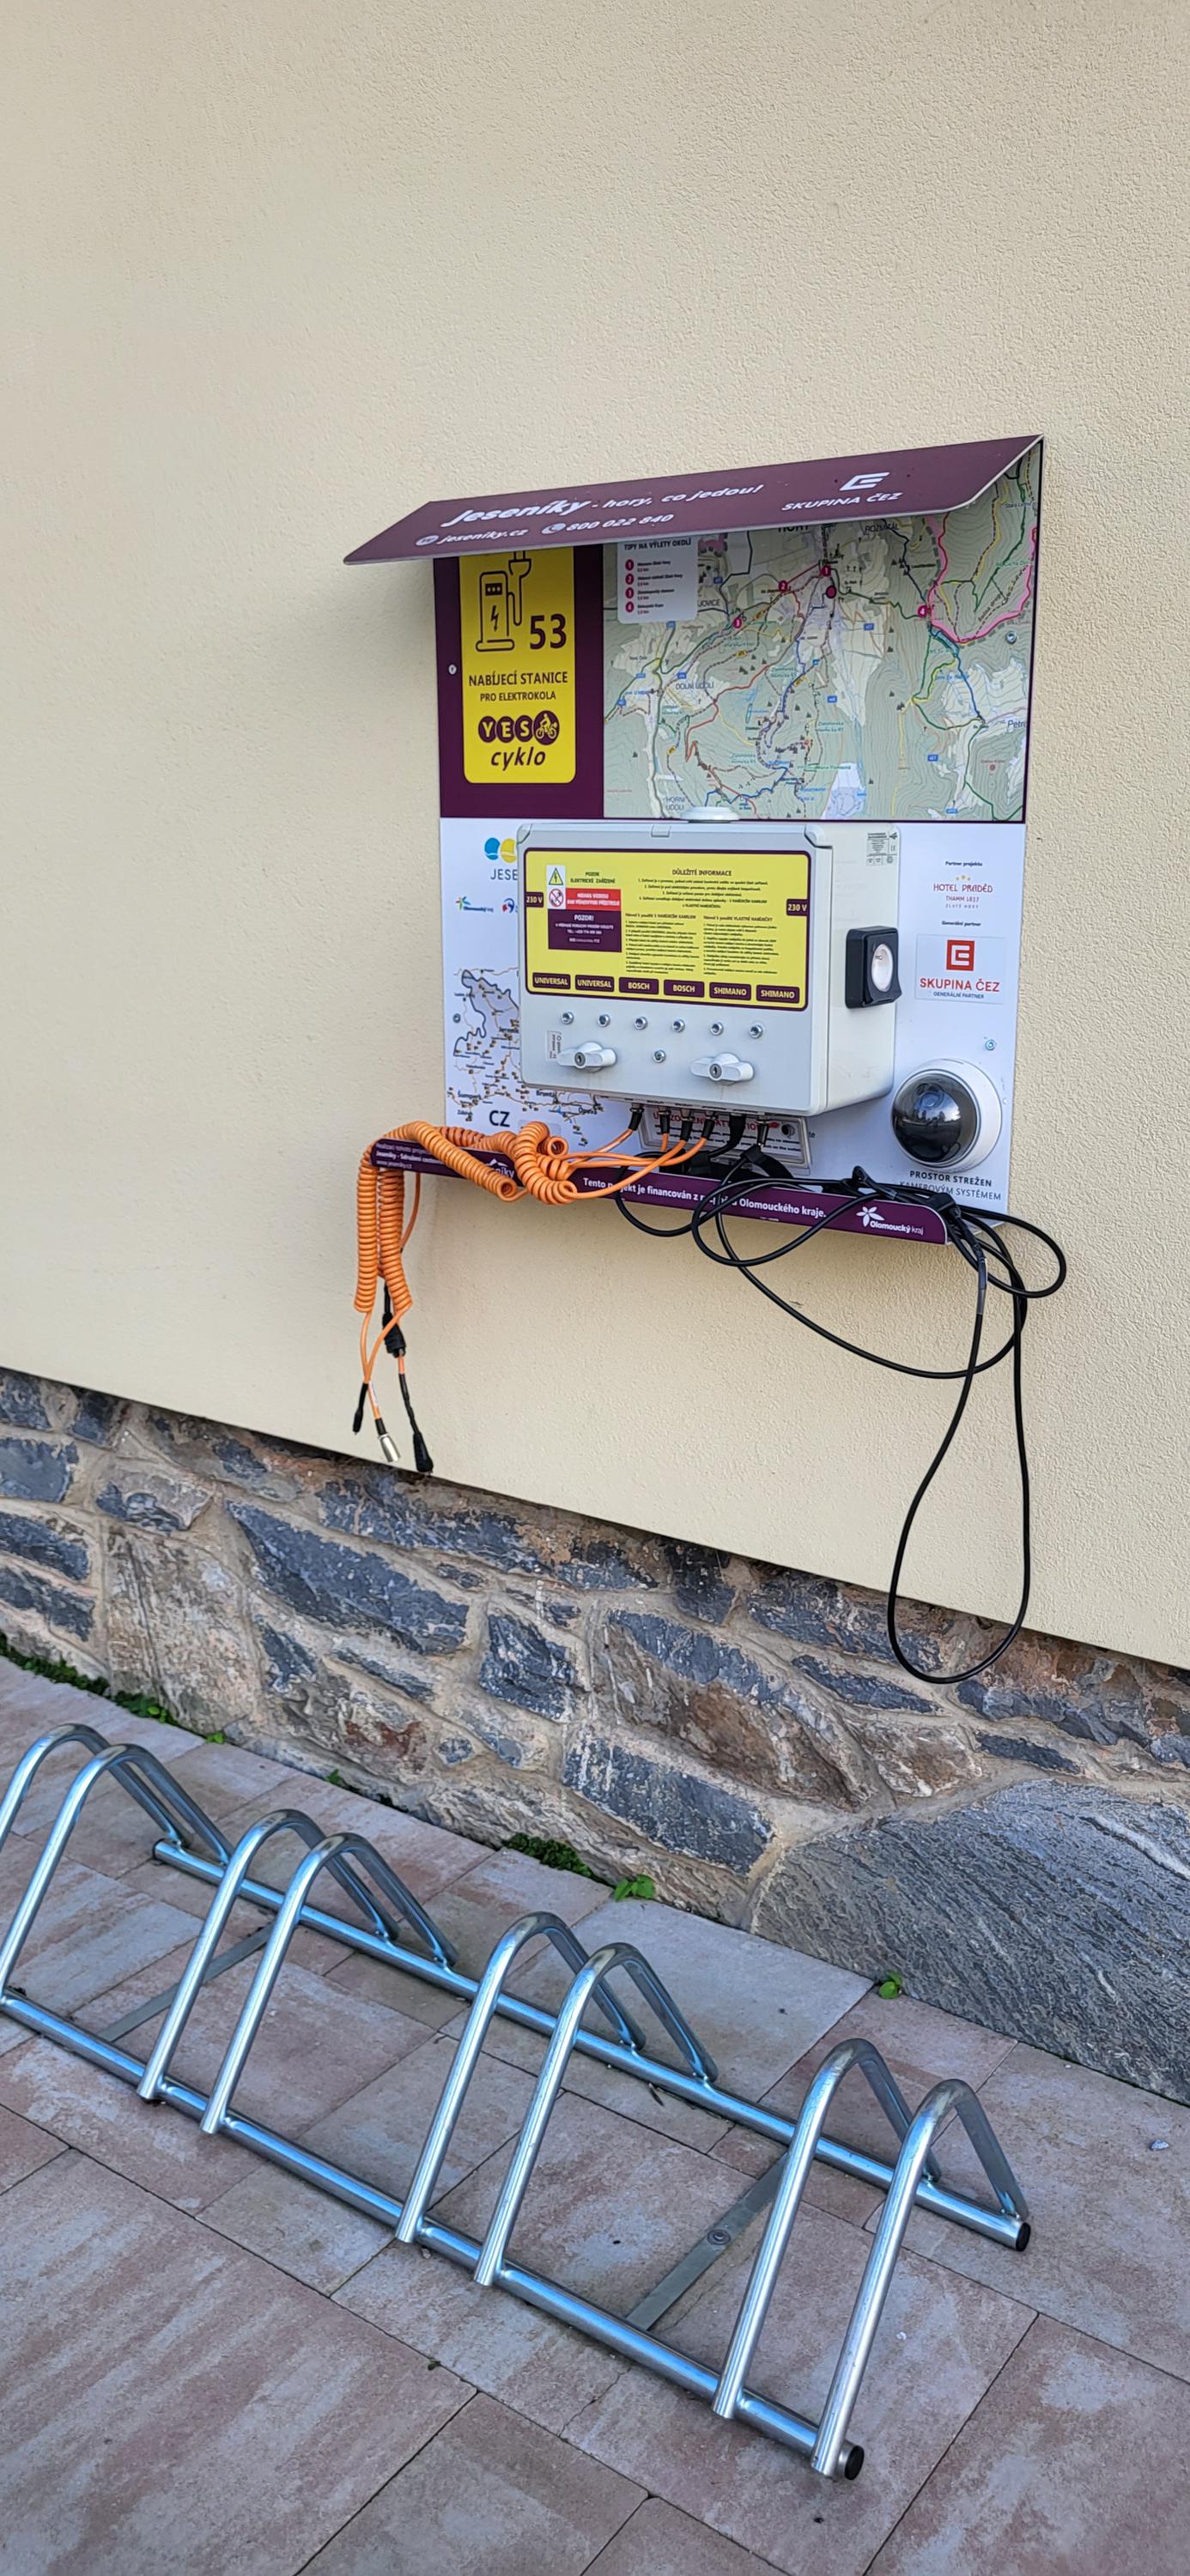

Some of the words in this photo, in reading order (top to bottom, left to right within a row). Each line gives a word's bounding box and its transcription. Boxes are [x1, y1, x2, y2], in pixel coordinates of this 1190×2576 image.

[440, 499, 592, 527] Jeseníky
[602, 496, 653, 510] hory,
[661, 493, 688, 503] co
[685, 483, 764, 503] jedou!
[781, 495, 861, 511] SKUPINA
[866, 492, 903, 503] ČEZ
[566, 521, 600, 532] 800
[602, 517, 637, 528] 022
[638, 513, 675, 526] 840
[436, 529, 529, 544] jeseniky.cz
[529, 613, 568, 650] 53
[469, 670, 518, 687] NABÍJECÍ
[520, 671, 568, 685] STANICE
[480, 692, 496, 702] PRO
[499, 690, 556, 702] ELEKTROKOLA
[480, 718, 532, 739] YES
[490, 746, 546, 771] cyklo
[490, 868, 519, 881] JESE
[933, 884, 958, 892] HOTEL
[787, 902, 800, 911] 230
[801, 903, 808, 912] V
[534, 976, 568, 986] UNIVERSAL
[577, 979, 612, 988] UNIVERSAL
[628, 981, 650, 990] BOSCH
[672, 984, 695, 993] BOSCH
[920, 978, 972, 991] SKUPINA
[975, 978, 1000, 993] ČEZ
[713, 987, 747, 996] SHIMANO
[761, 989, 795, 999] SHIMANO
[489, 1109, 511, 1127] CZ
[910, 1170, 950, 1182] PROSTOR
[583, 1177, 606, 1188] Tento
[607, 1182, 636, 1194] pjekt
[637, 1184, 646, 1195] je
[647, 1186, 692, 1200] financován
[738, 1197, 800, 1214] Olomouckého
[801, 1206, 827, 1219] kraje.
[870, 1219, 911, 1234] Olomoucký
[911, 1225, 924, 1236] kraj
